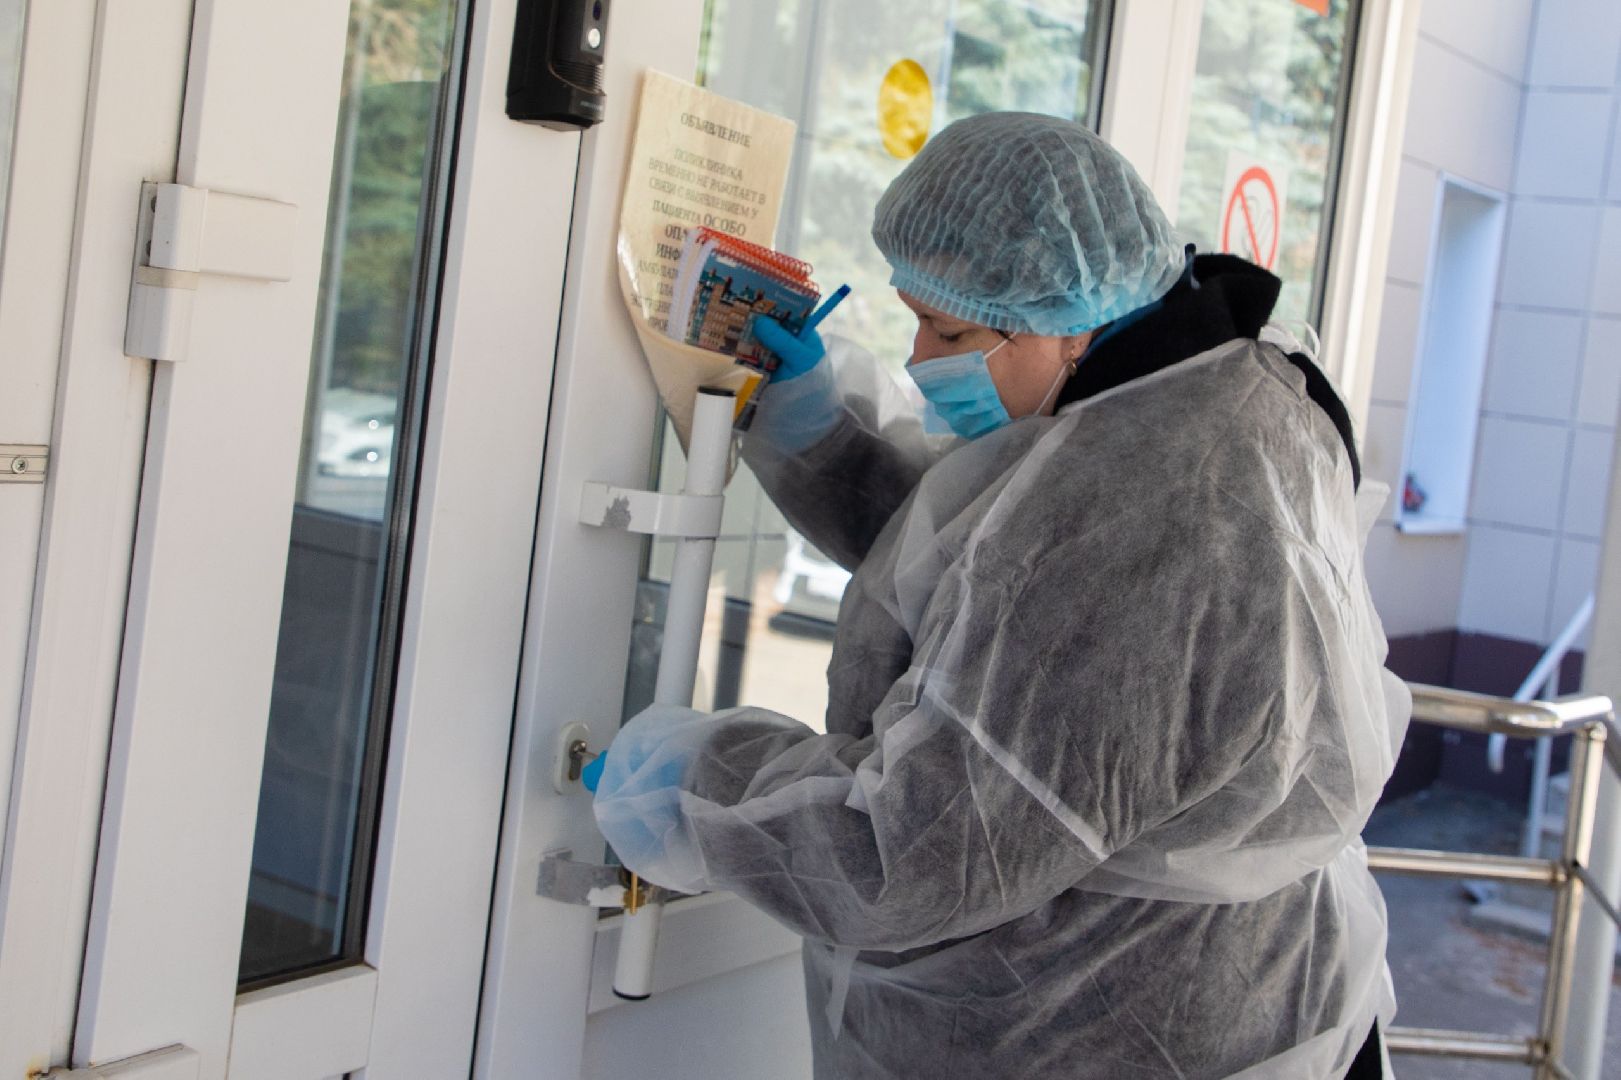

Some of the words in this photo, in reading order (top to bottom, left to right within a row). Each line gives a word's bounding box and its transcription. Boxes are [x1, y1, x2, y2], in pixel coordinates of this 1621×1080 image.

[680, 112, 752, 148] ОБЪЯВЛЕНИЕ
[649, 157, 696, 186] ВРЕМЕННО
[697, 172, 709, 187] НЕ
[709, 175, 758, 203] РАБОТАЕТ
[758, 192, 766, 205] В
[652, 199, 701, 225] ПАЦИЕНТА
[703, 212, 747, 237] ОСОБО
